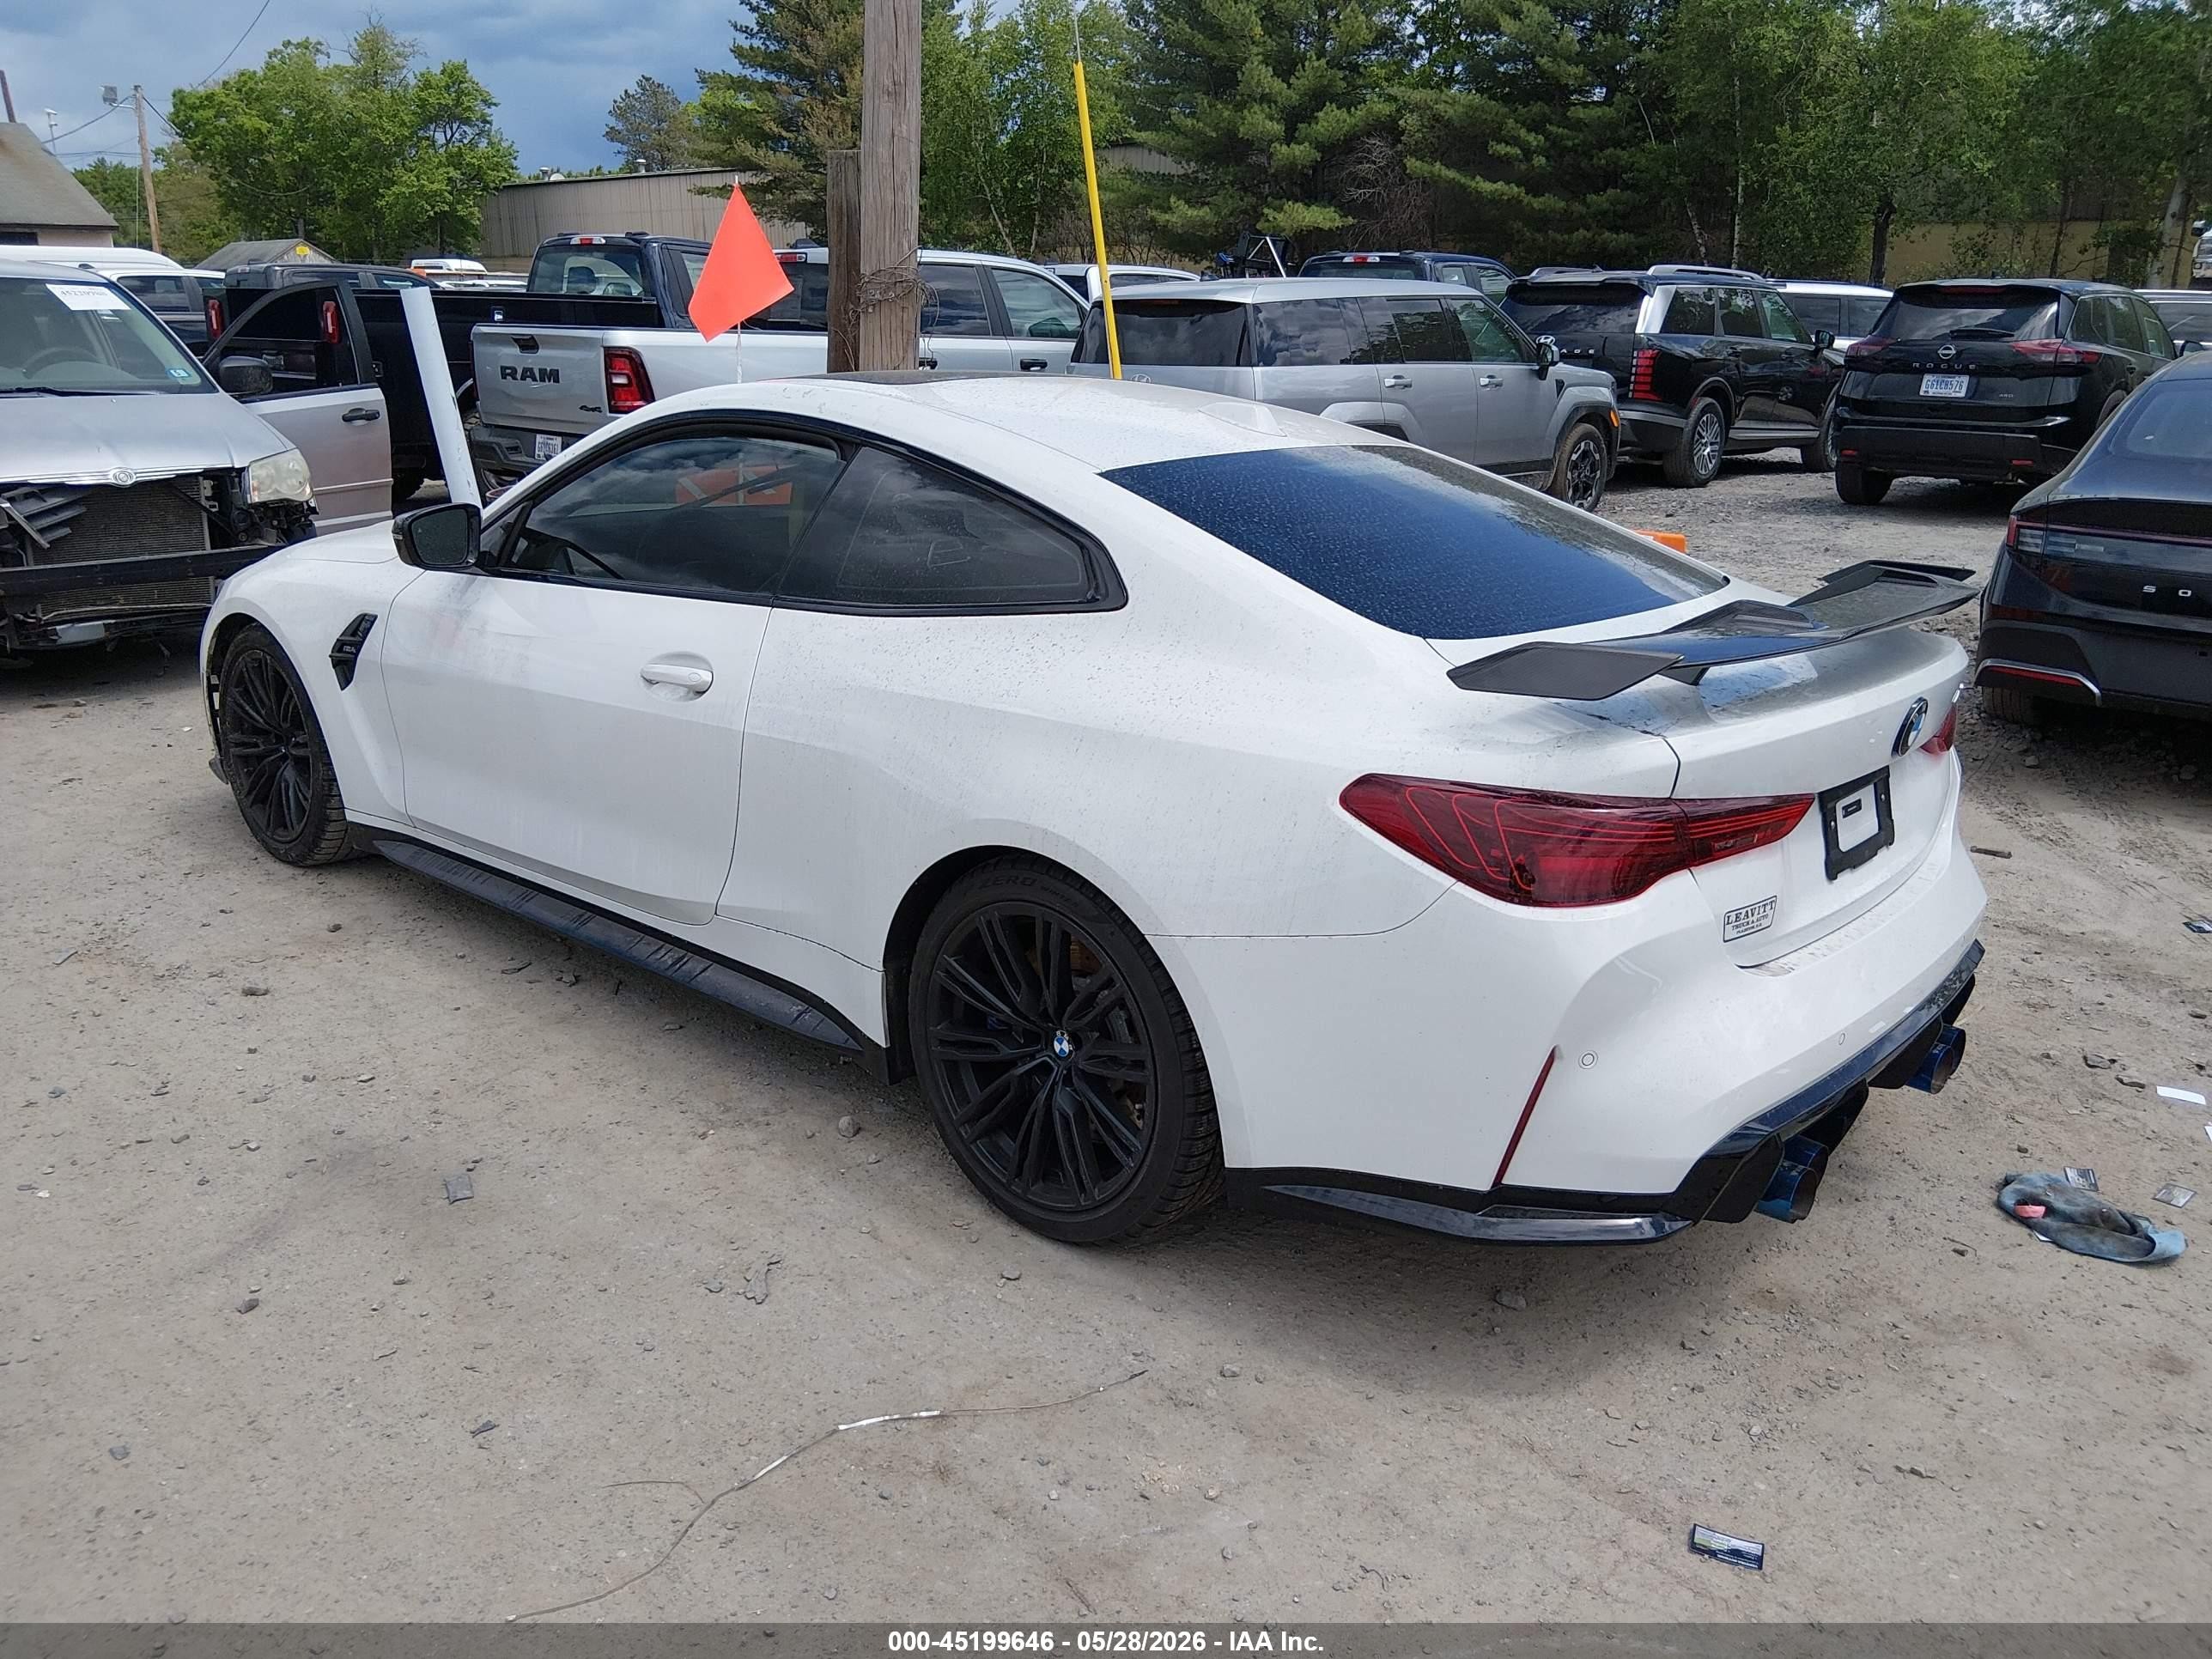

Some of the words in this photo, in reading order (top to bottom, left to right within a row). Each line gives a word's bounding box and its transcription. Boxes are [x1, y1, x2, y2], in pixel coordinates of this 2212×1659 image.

[500, 365, 560, 384] RAM
[1925, 379, 1965, 391] G61C8576
[1725, 900, 1776, 926] LEAVITT
[1731, 920, 1750, 931] TRUCK
[1755, 914, 1769, 923] AUTO
